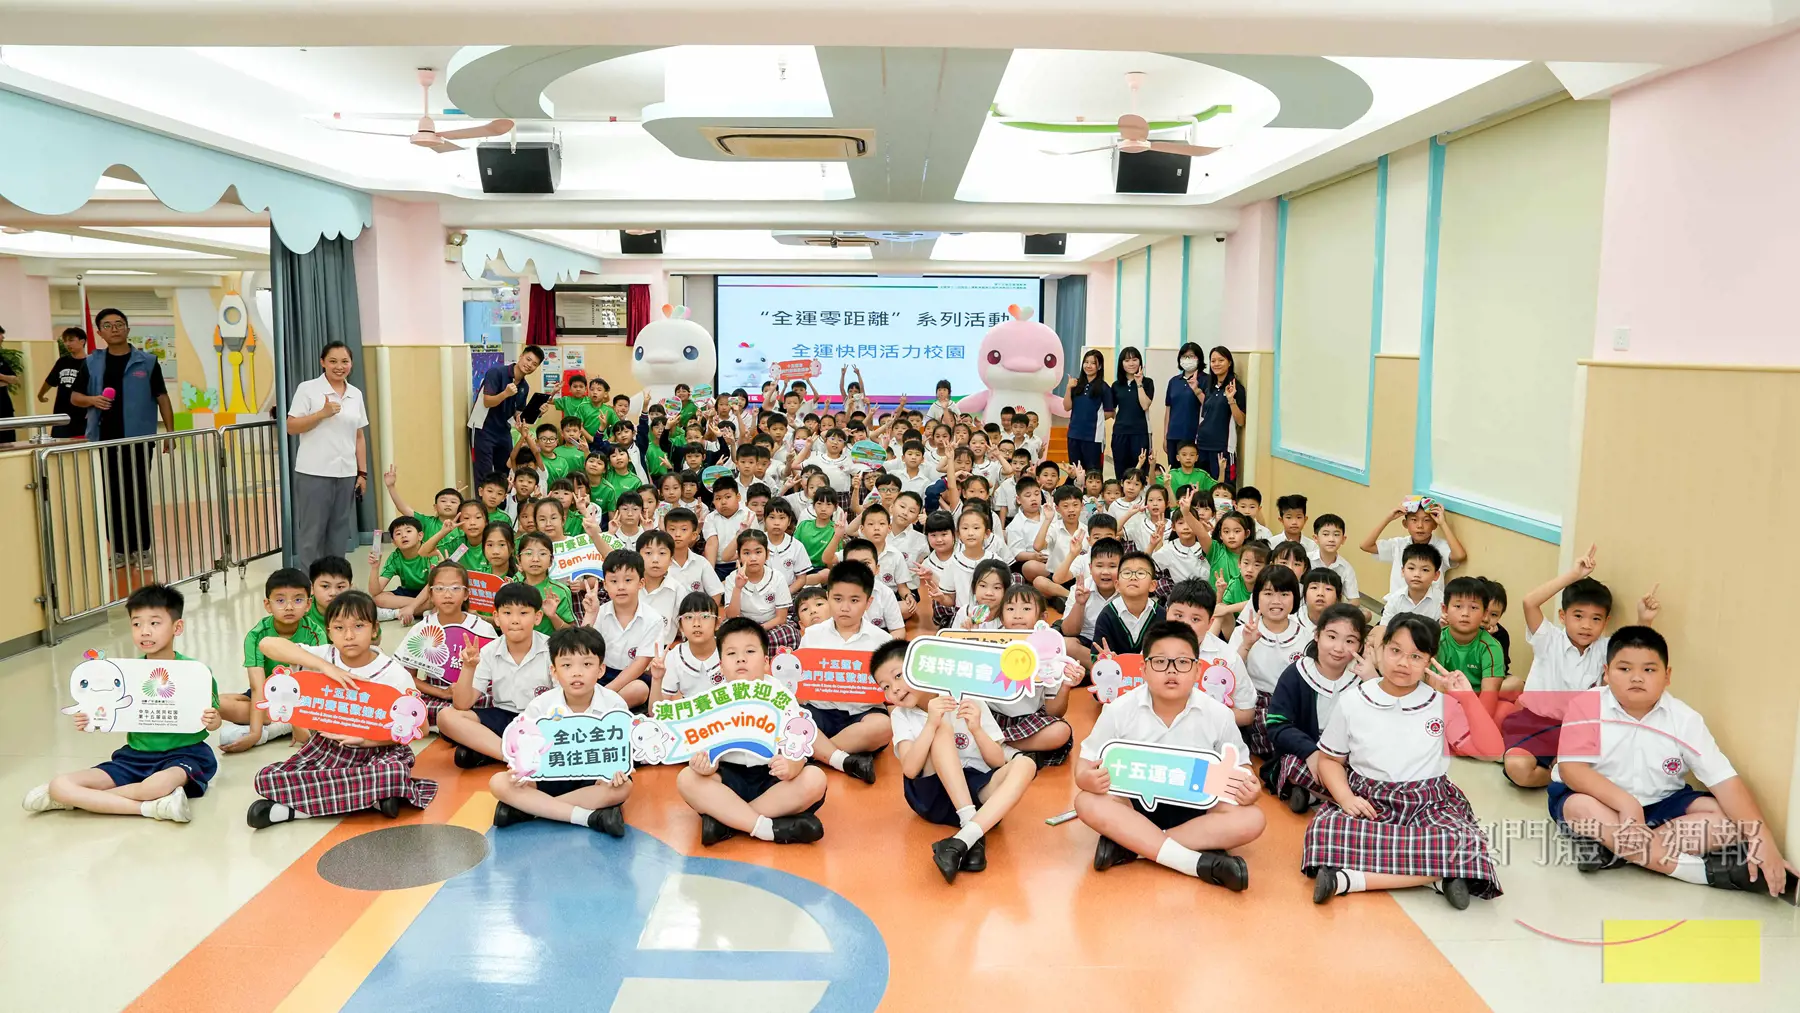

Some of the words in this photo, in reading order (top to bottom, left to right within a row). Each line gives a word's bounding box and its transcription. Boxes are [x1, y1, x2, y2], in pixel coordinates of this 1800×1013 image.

[916, 311, 1010, 328] 系列活動
[791, 343, 965, 360] 全運快閃活力校園
[553, 533, 624, 554] 門賽區迎您
[557, 550, 605, 569] Bem-vin
[818, 657, 863, 671] 十五運會
[918, 654, 993, 682] 殘特奧會
[320, 684, 371, 704] 十五運會
[655, 682, 793, 721] 澳門賽區歡迎您
[553, 724, 624, 746] 全心全力
[684, 711, 776, 745] Bem-vindo
[548, 746, 627, 768] 勇往直前!
[1109, 758, 1187, 787] 十五運會
